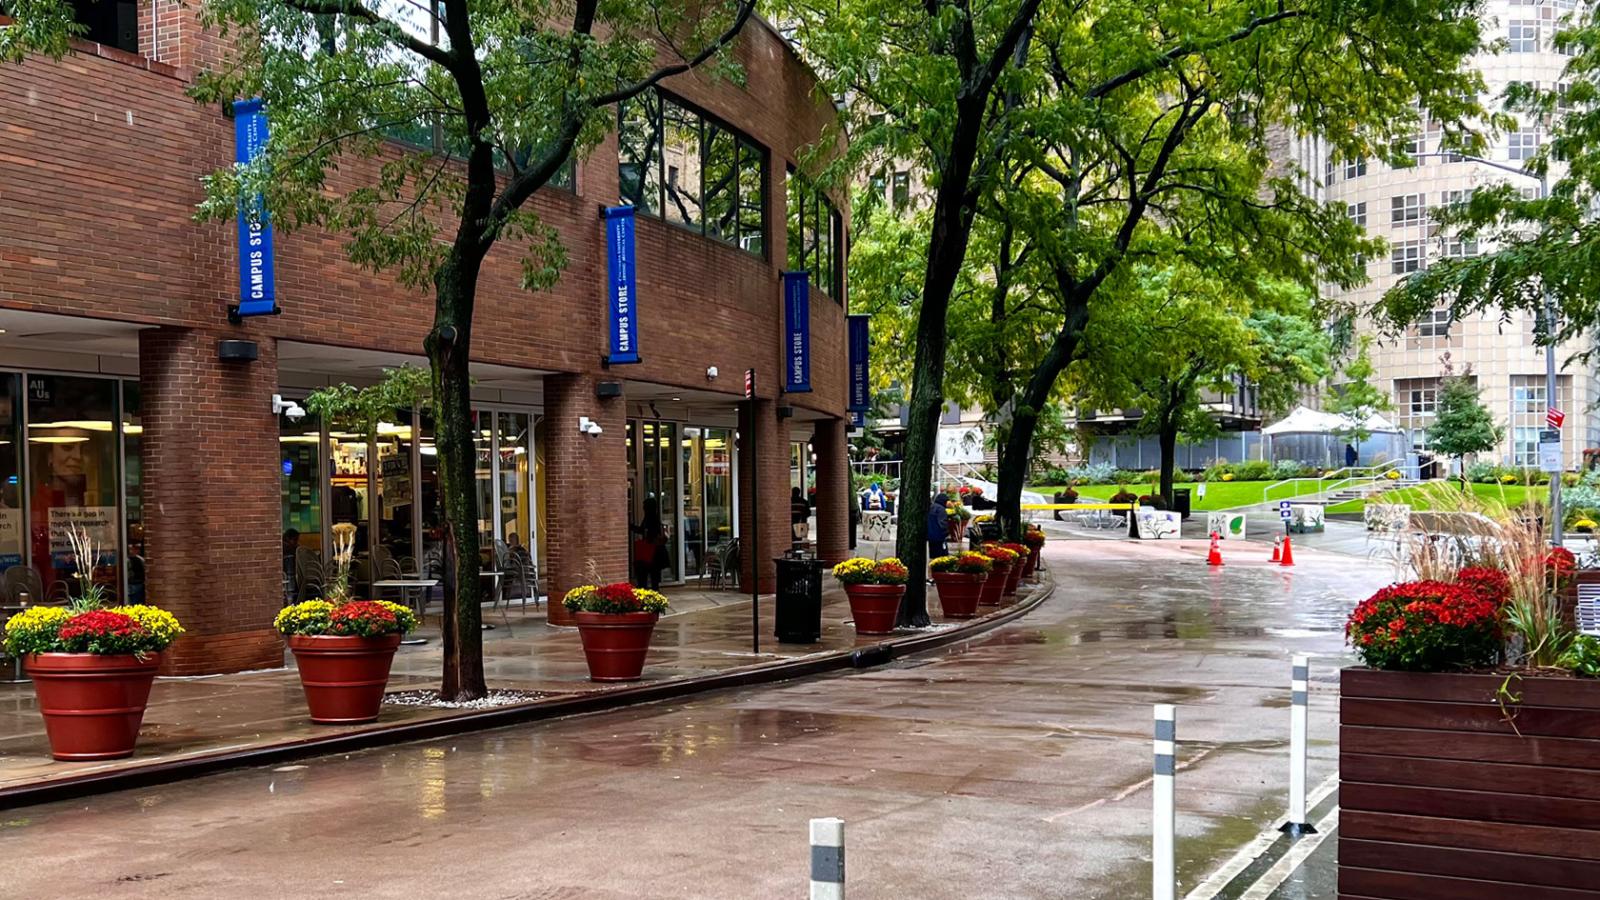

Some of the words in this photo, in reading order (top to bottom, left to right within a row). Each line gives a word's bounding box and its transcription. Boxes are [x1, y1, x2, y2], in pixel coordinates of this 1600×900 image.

[250, 251, 263, 299] CAMPUS
[618, 284, 628, 314] STORE
[618, 316, 629, 352] CAMPUS
[793, 332, 802, 354] STORE
[793, 356, 802, 384] CAMPUS
[855, 363, 863, 382] STORE
[29, 380, 45, 390] All
[36, 389, 50, 399] Us
[855, 383, 863, 405] CAMPUS
